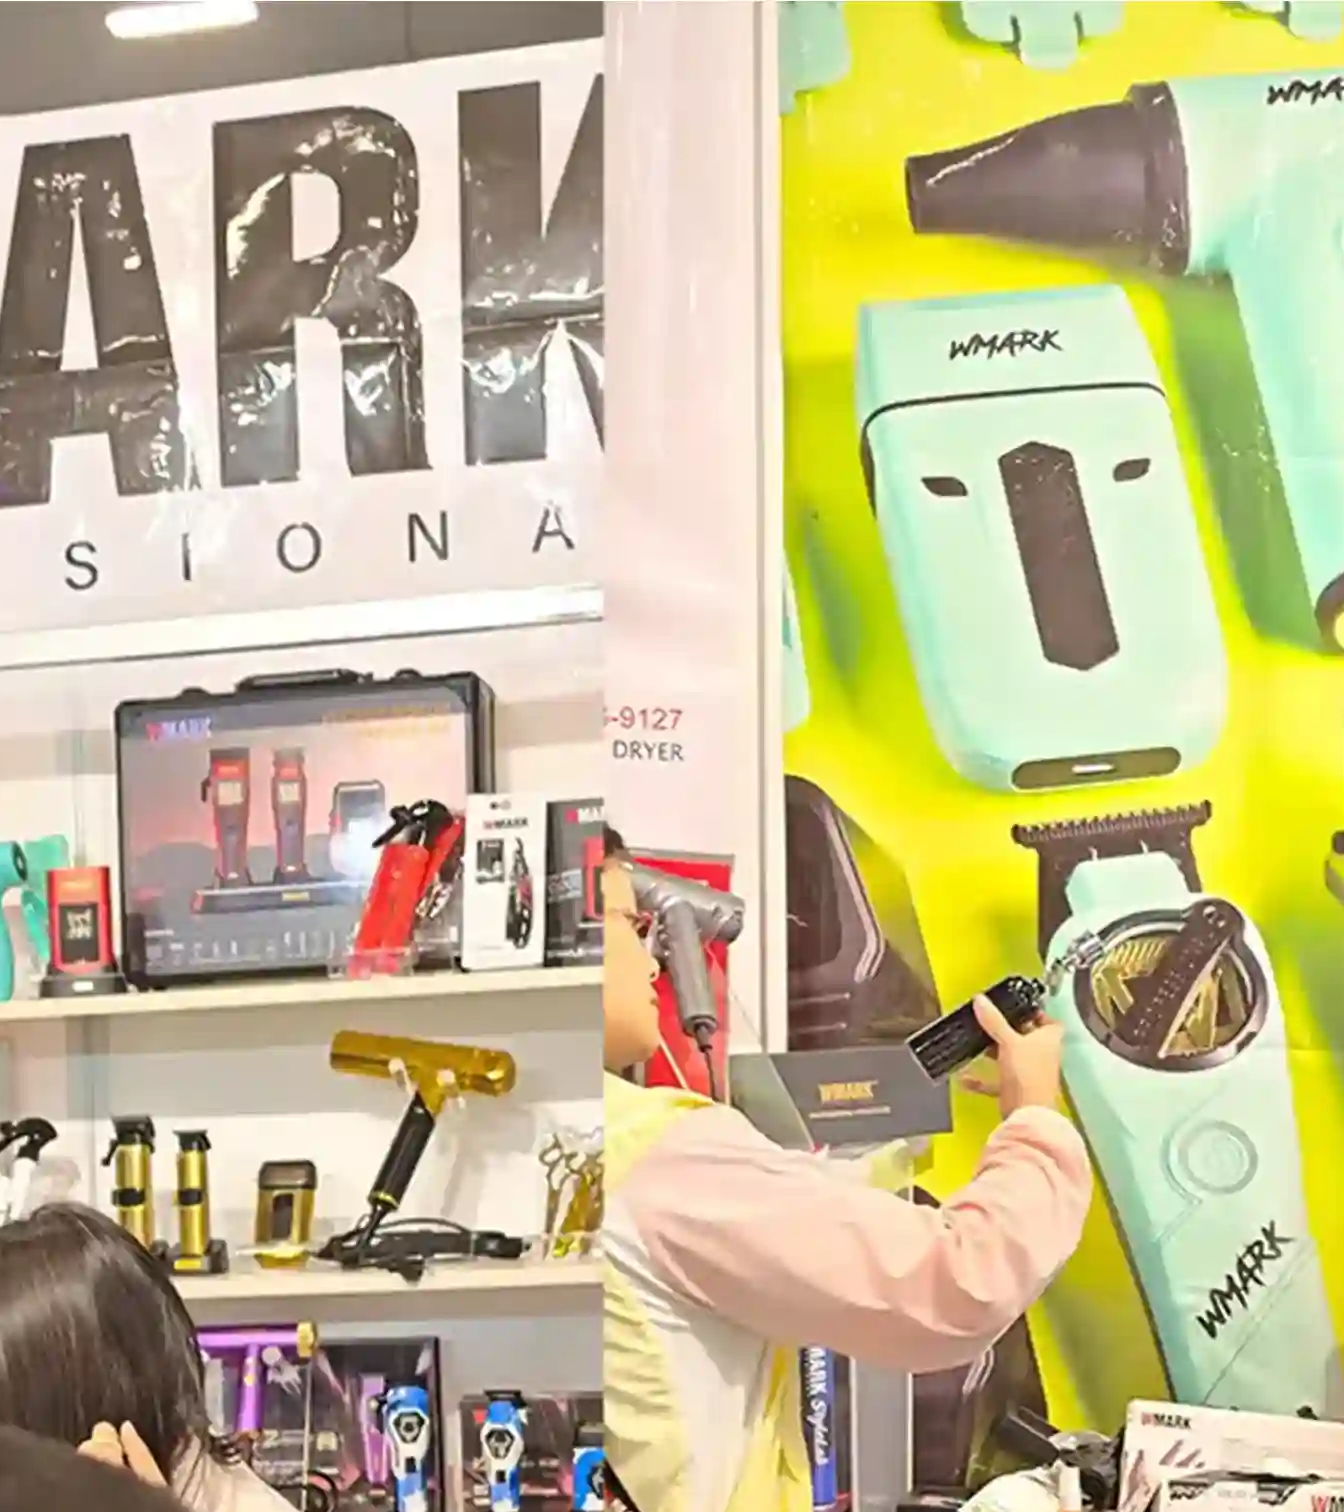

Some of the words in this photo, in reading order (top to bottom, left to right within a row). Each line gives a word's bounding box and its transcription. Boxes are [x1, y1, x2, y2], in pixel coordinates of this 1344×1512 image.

[949, 328, 1064, 361] WMARK
[612, 739, 684, 762] DRYER
[1195, 1219, 1297, 1340] WMARK
[1140, 1410, 1192, 1430] WMARK
